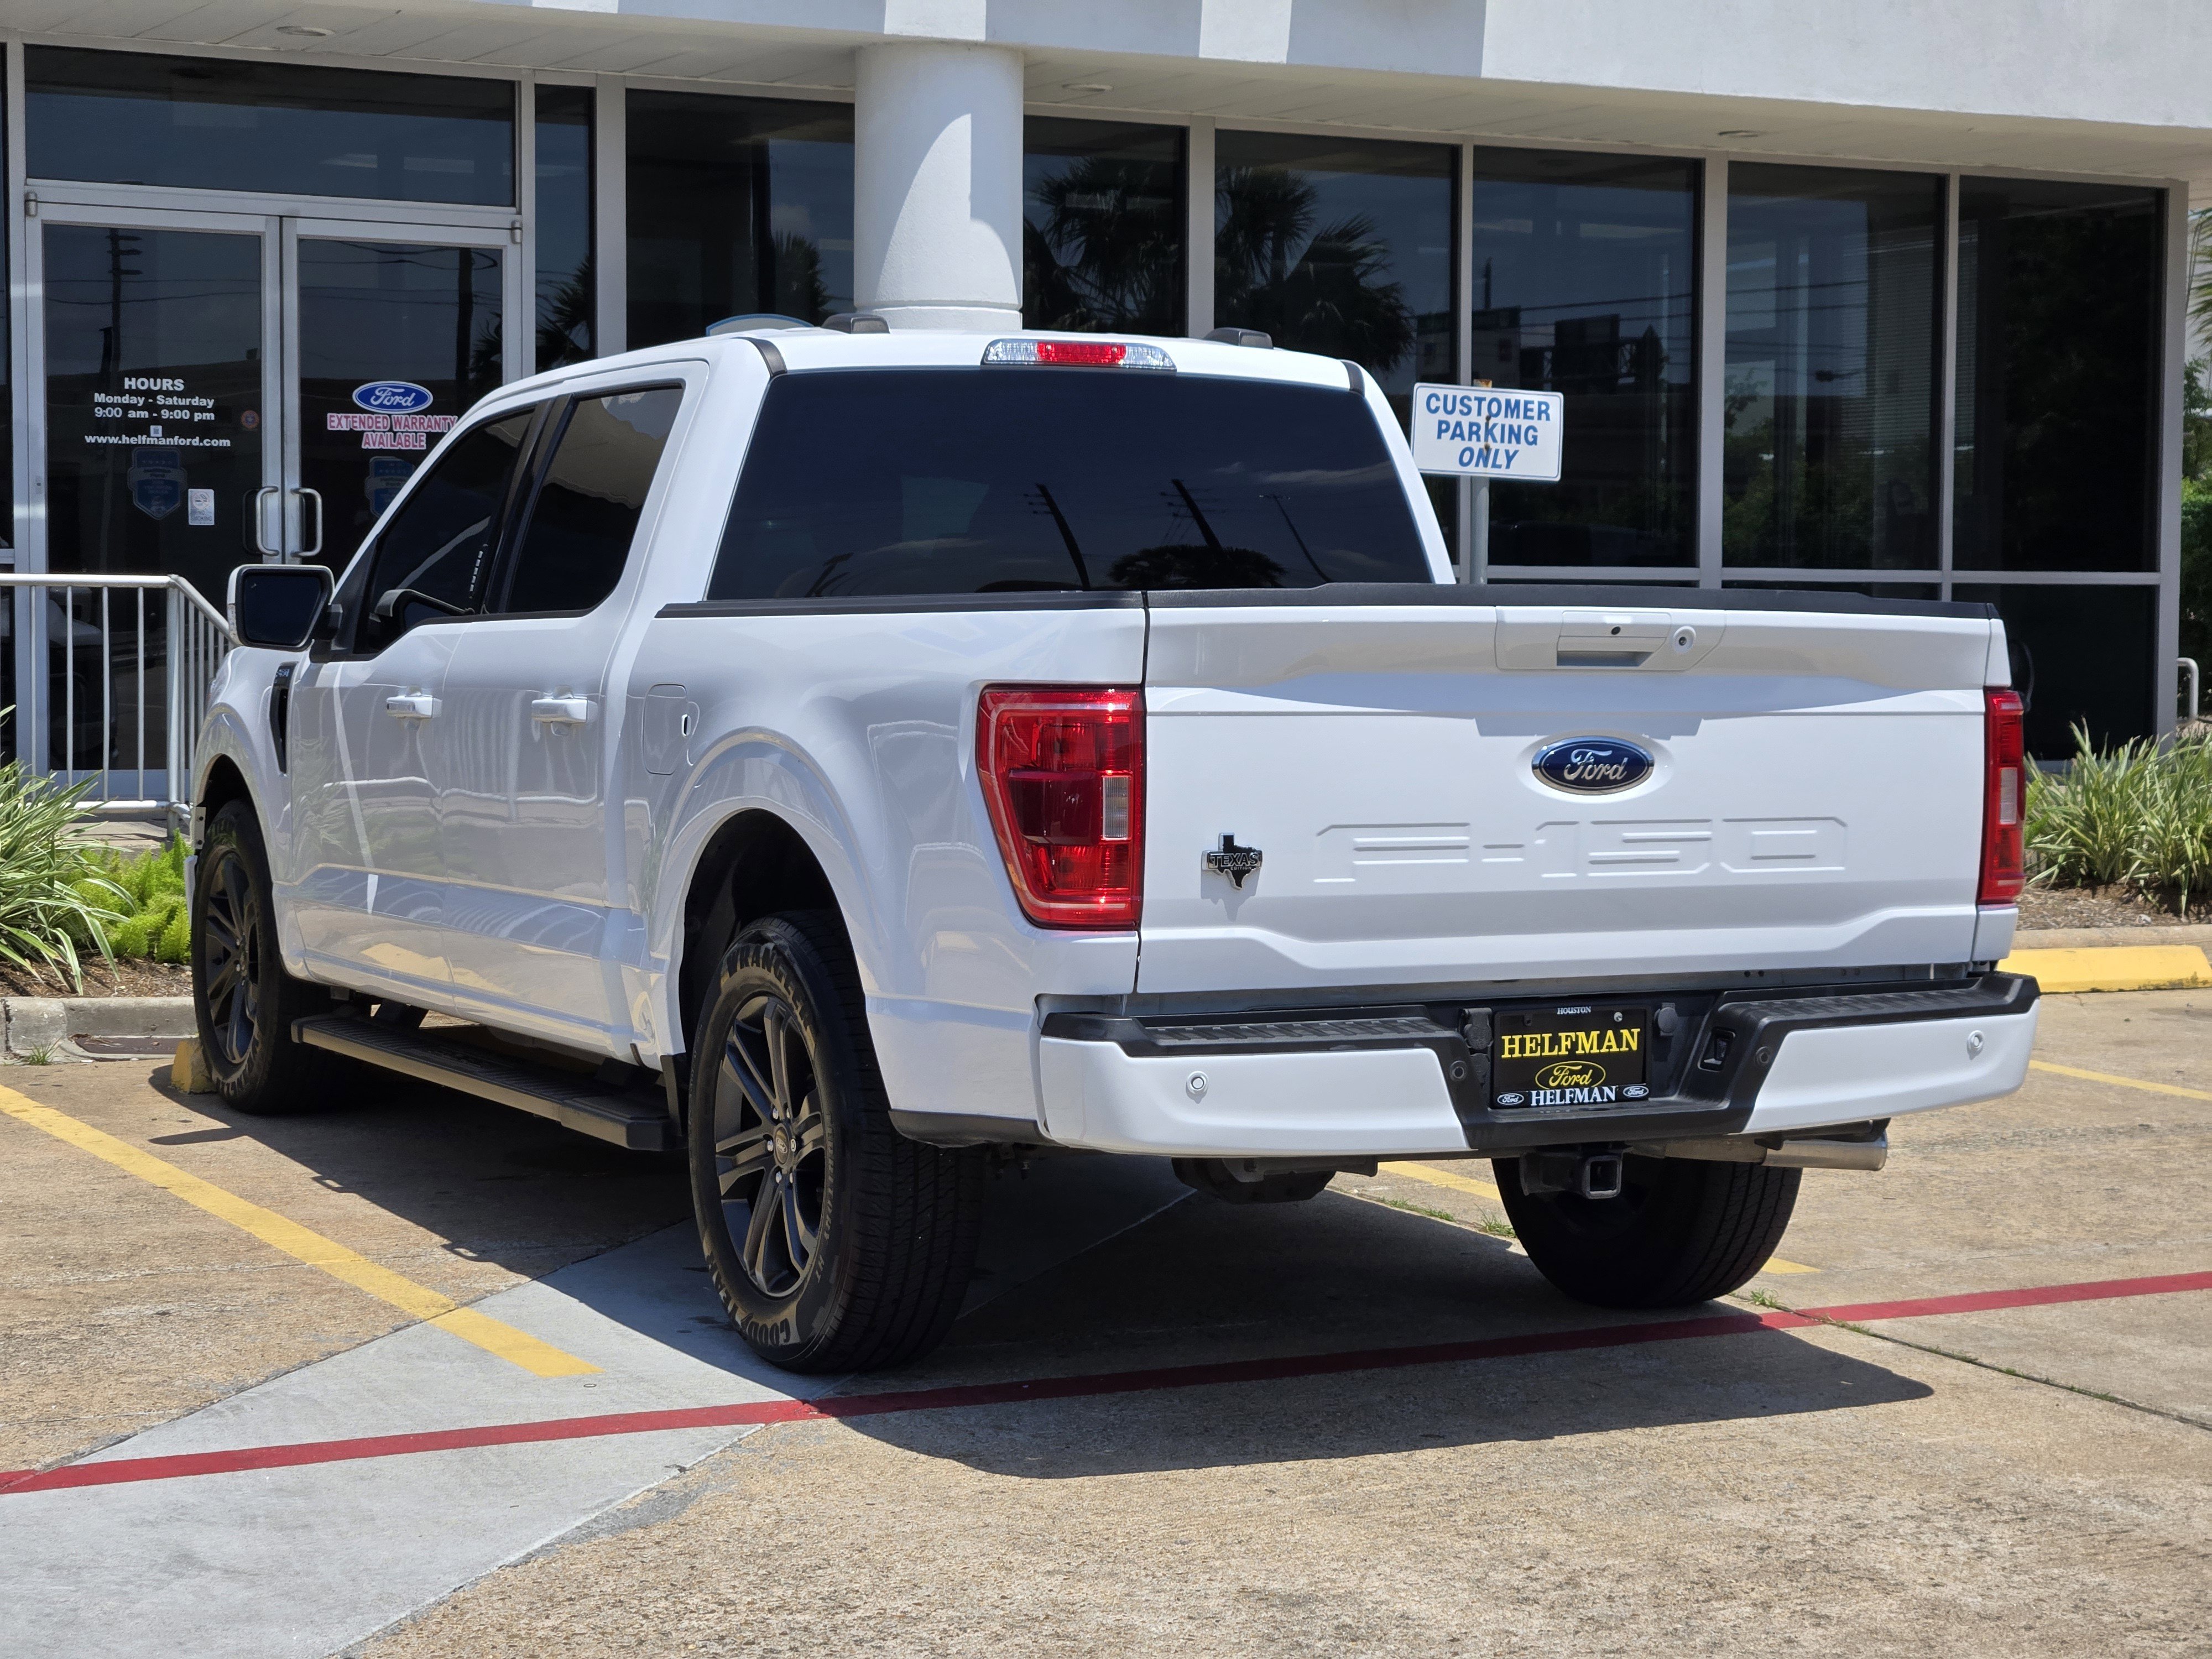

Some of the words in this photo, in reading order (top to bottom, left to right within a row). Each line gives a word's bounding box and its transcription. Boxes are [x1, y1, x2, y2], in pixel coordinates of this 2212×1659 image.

[124, 377, 185, 391] HOURS
[94, 393, 145, 406] Monday
[156, 395, 215, 408] Saturday
[371, 387, 416, 406] Ford
[95, 407, 122, 418] 9:00
[127, 410, 149, 418] am
[161, 409, 190, 419] 9:00
[194, 410, 215, 421] pm
[1426, 393, 1551, 421] CUSTOMER
[328, 414, 389, 430] EXTENDED
[392, 415, 457, 432] WARRANTY
[1437, 419, 1538, 446] PARKING
[85, 435, 231, 447] www.helfmanford.com
[362, 433, 425, 448] AVAILABLE
[1458, 446, 1520, 469] ONLY
[1563, 748, 1627, 781] Ford
[1313, 816, 1848, 883] F-150
[1211, 853, 1259, 867] TEXAS
[1557, 1006, 1592, 1015] HOUSTON
[1501, 1028, 1641, 1058] HELFMAN
[1549, 1065, 1593, 1086] Ford
[1502, 1095, 1519, 1103] Ford
[1531, 1086, 1617, 1106] HELFMAN
[1627, 1087, 1644, 1096] Ford
